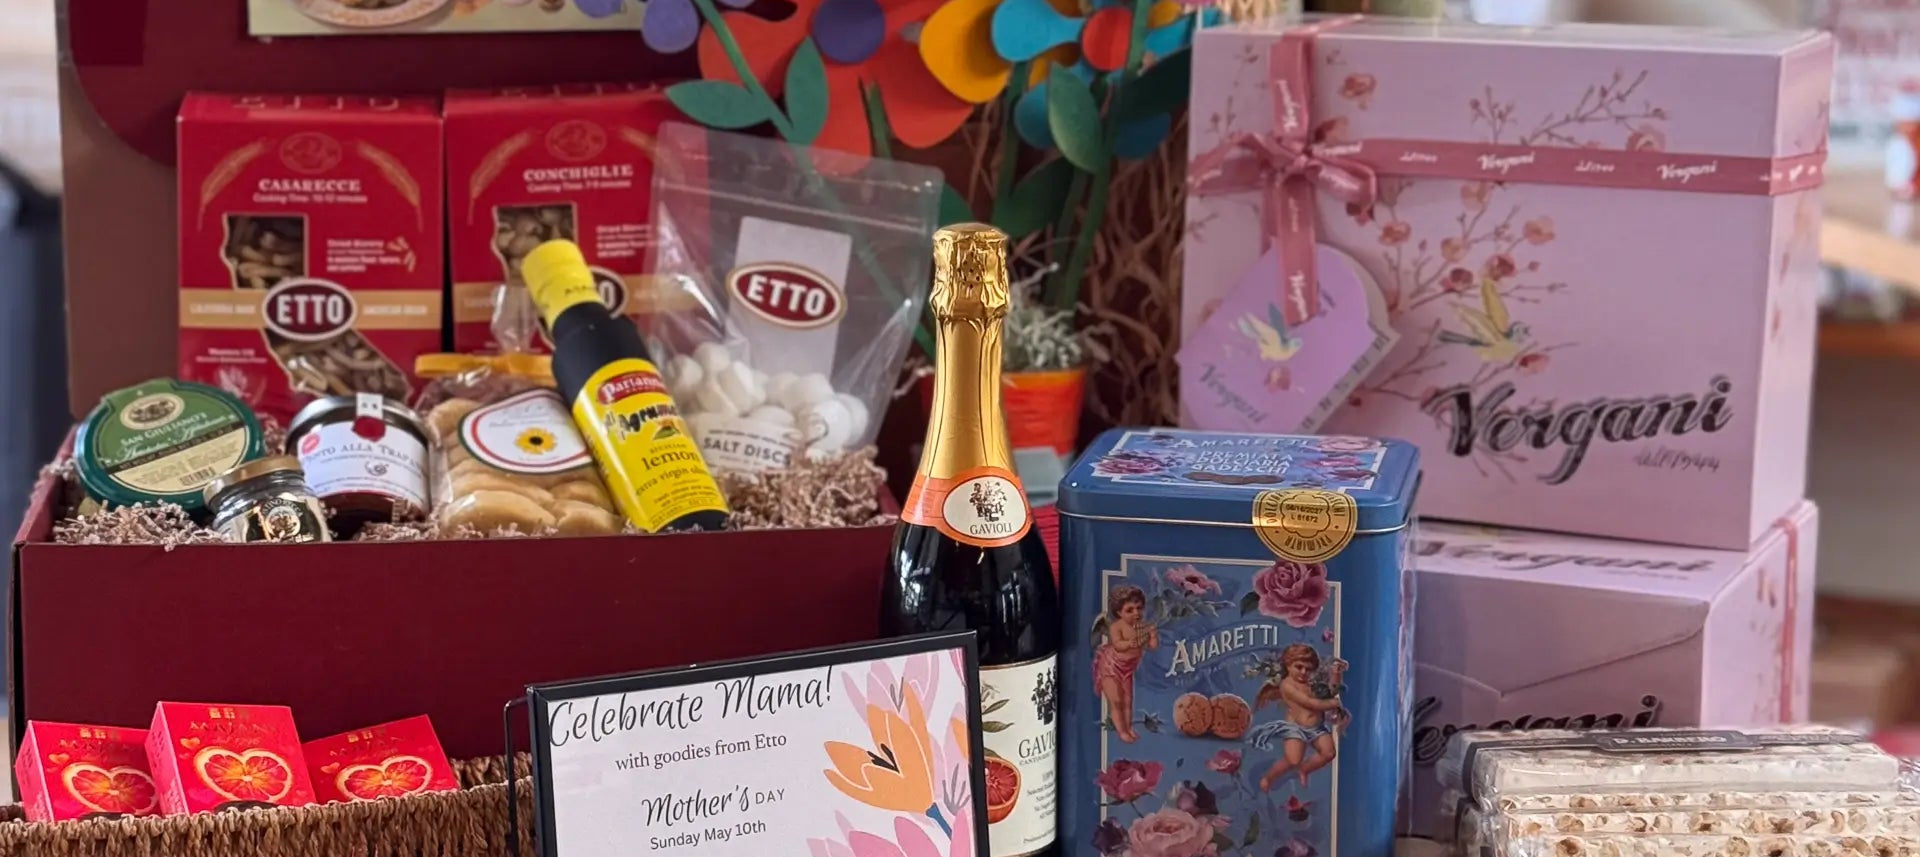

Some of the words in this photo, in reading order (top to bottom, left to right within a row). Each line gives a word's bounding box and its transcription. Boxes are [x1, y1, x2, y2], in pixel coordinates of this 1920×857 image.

[523, 164, 634, 181] CONCHIGLIE
[1477, 151, 1536, 173] Vergani
[1657, 160, 1719, 185] Vergani
[258, 179, 362, 193] CASARECCE
[747, 273, 827, 317] ETTO
[276, 294, 345, 325] ETTO
[1419, 374, 1735, 485] Vergani
[339, 442, 373, 452] ALLA
[703, 438, 740, 453] SALT
[744, 444, 792, 468] DISCS
[1172, 438, 1312, 449] AMARETTI
[1200, 451, 1294, 461] PREMIATA
[641, 449, 701, 472] lemon
[969, 522, 1013, 536] GAVIOLI
[1165, 624, 1279, 679] AMARETTI
[549, 692, 704, 748] Celebrate
[714, 665, 834, 721] Mama!
[615, 752, 650, 771] with
[653, 744, 711, 770] goodies
[715, 741, 751, 758] from
[754, 733, 787, 750] Etto
[641, 785, 750, 828] Mother's
[755, 788, 786, 805] DAY
[650, 831, 701, 850] Sunday
[704, 827, 734, 845] May
[735, 820, 767, 838] 10th
